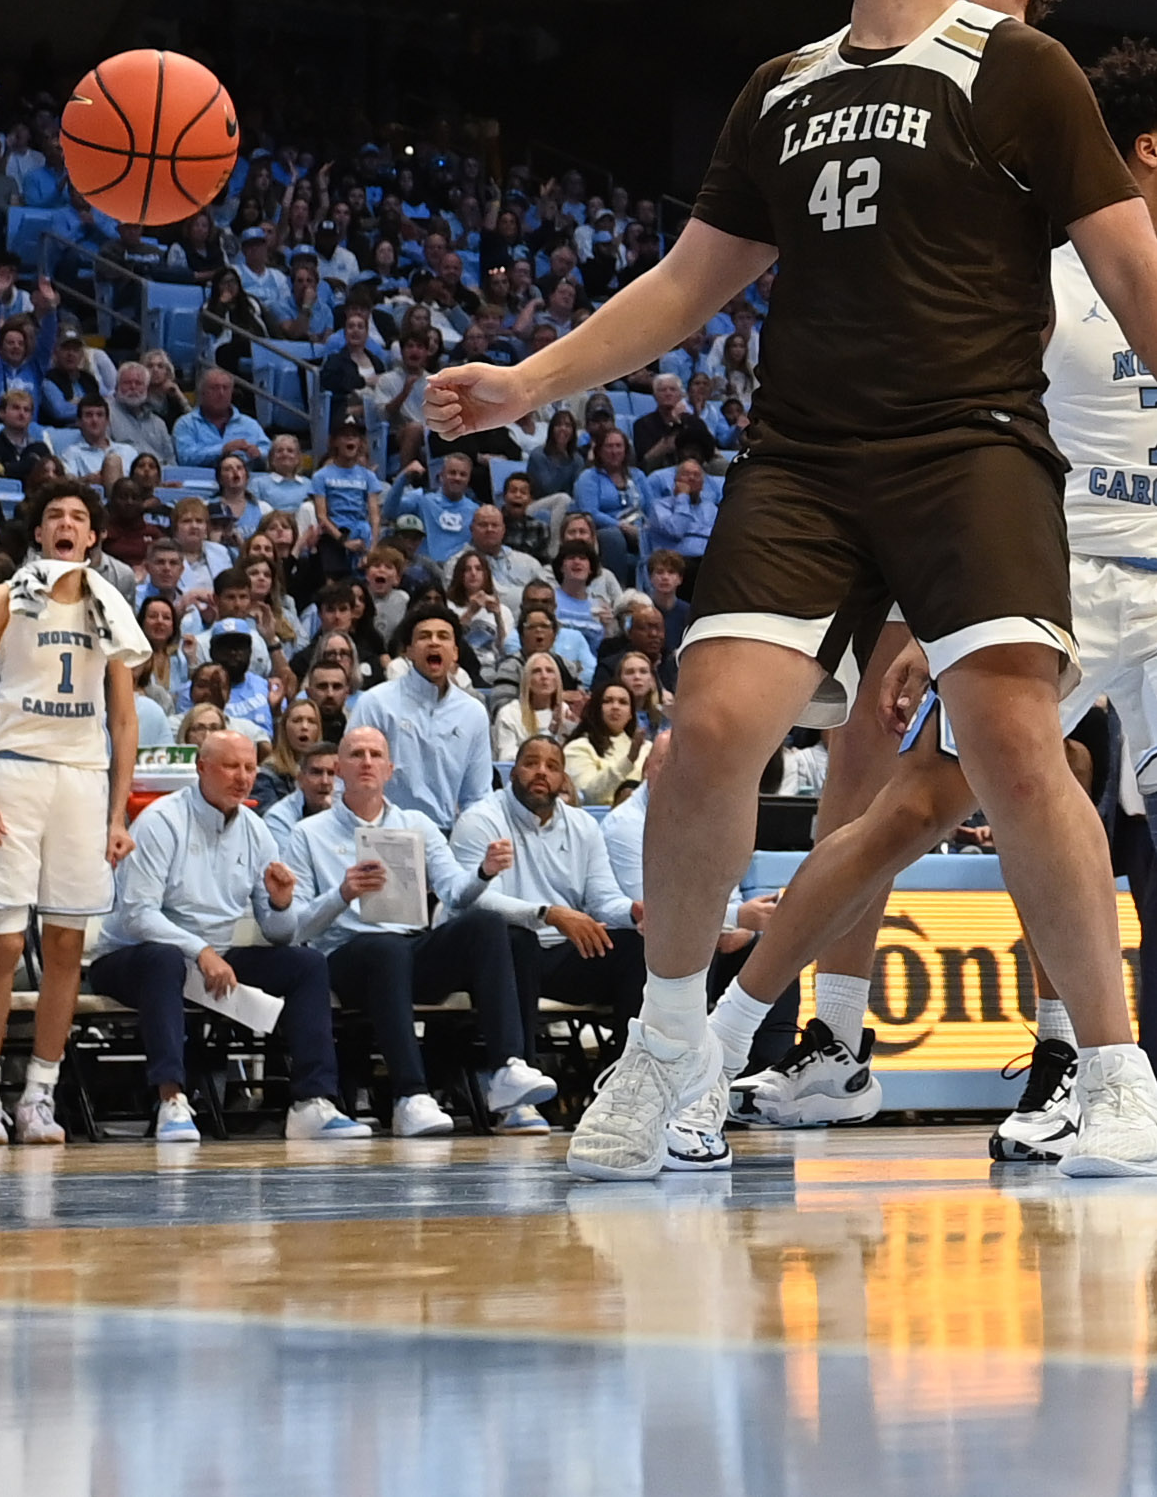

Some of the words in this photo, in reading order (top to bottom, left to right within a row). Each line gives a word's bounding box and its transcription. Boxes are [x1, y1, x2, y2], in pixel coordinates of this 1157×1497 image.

[779, 103, 931, 166] LEHIGH
[807, 156, 881, 232] 42
[1089, 467, 1157, 506] CAR
[37, 631, 93, 650] NORTH
[57, 652, 74, 694] 1
